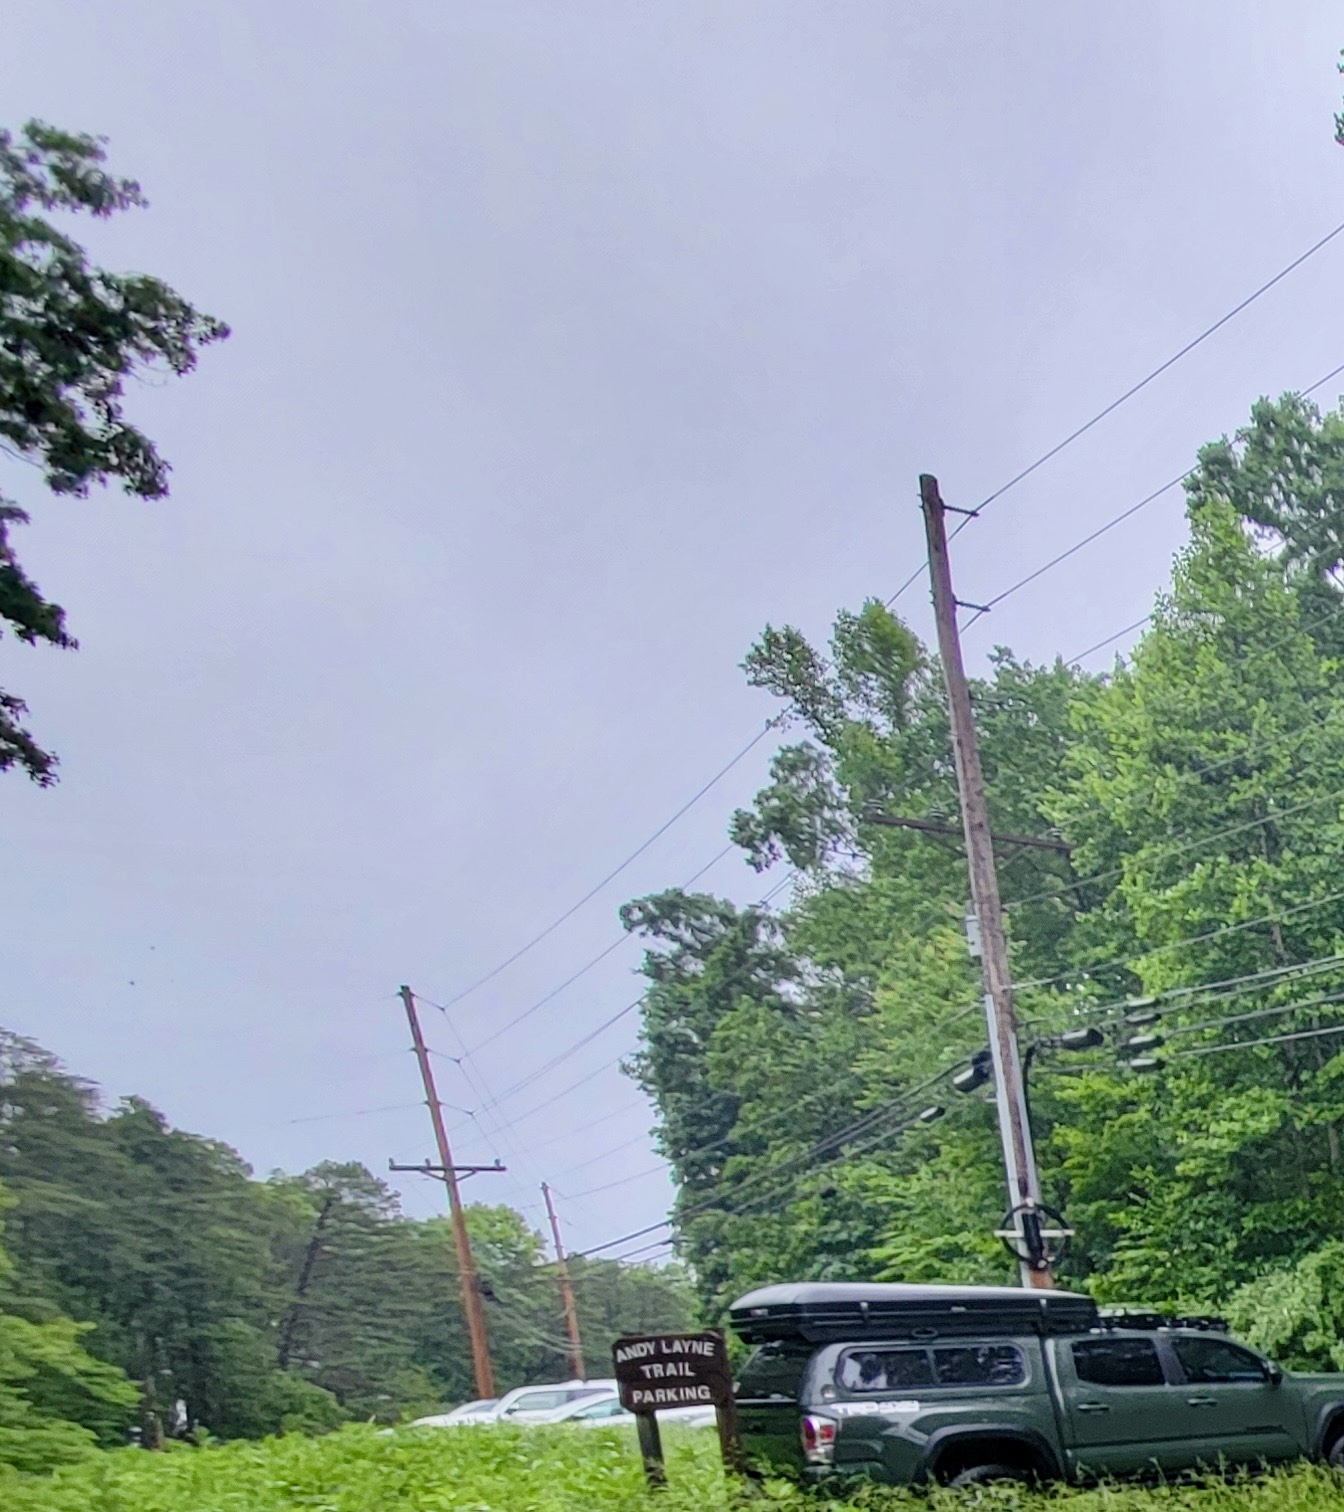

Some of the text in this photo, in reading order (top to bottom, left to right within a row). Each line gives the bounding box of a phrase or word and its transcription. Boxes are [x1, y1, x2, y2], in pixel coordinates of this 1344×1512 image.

[616, 1340, 715, 1362] ANDY LAYNE
[640, 1362, 696, 1379] TRAIL
[632, 1385, 711, 1403] PARKING
